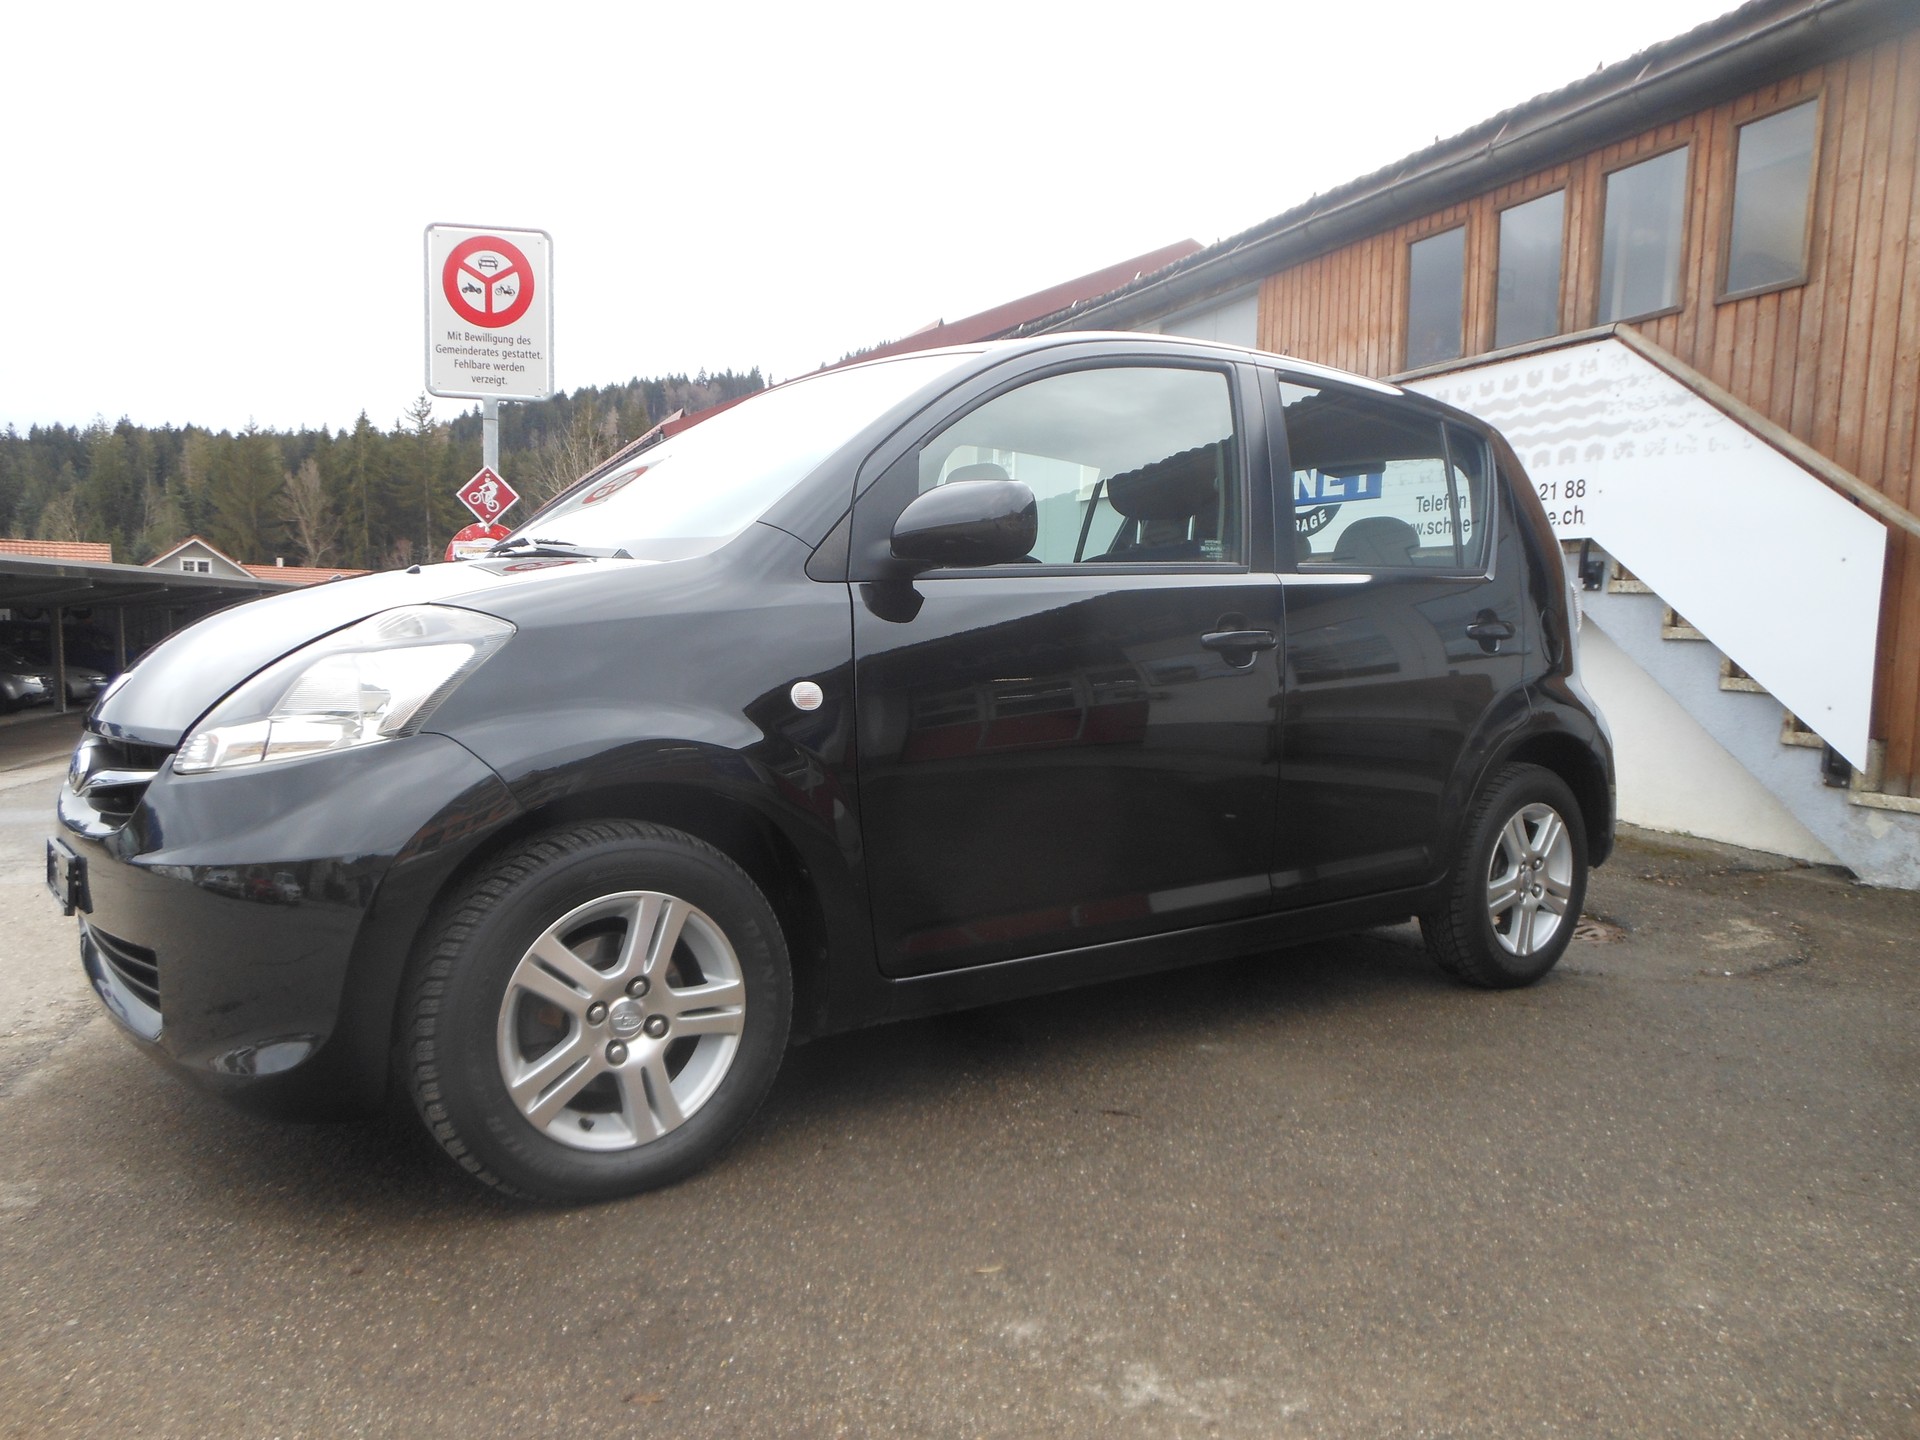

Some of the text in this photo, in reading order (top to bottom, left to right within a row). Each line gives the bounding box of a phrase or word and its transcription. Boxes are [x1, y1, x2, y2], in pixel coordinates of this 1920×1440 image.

[447, 331, 532, 346] Mit Bewilligung des
[435, 344, 543, 360] Gemeinderates gestattet.
[454, 359, 525, 372] Fehlbare werden
[471, 375, 508, 387] verzeigt.
[1415, 479, 1586, 513] Telefn 21 88
